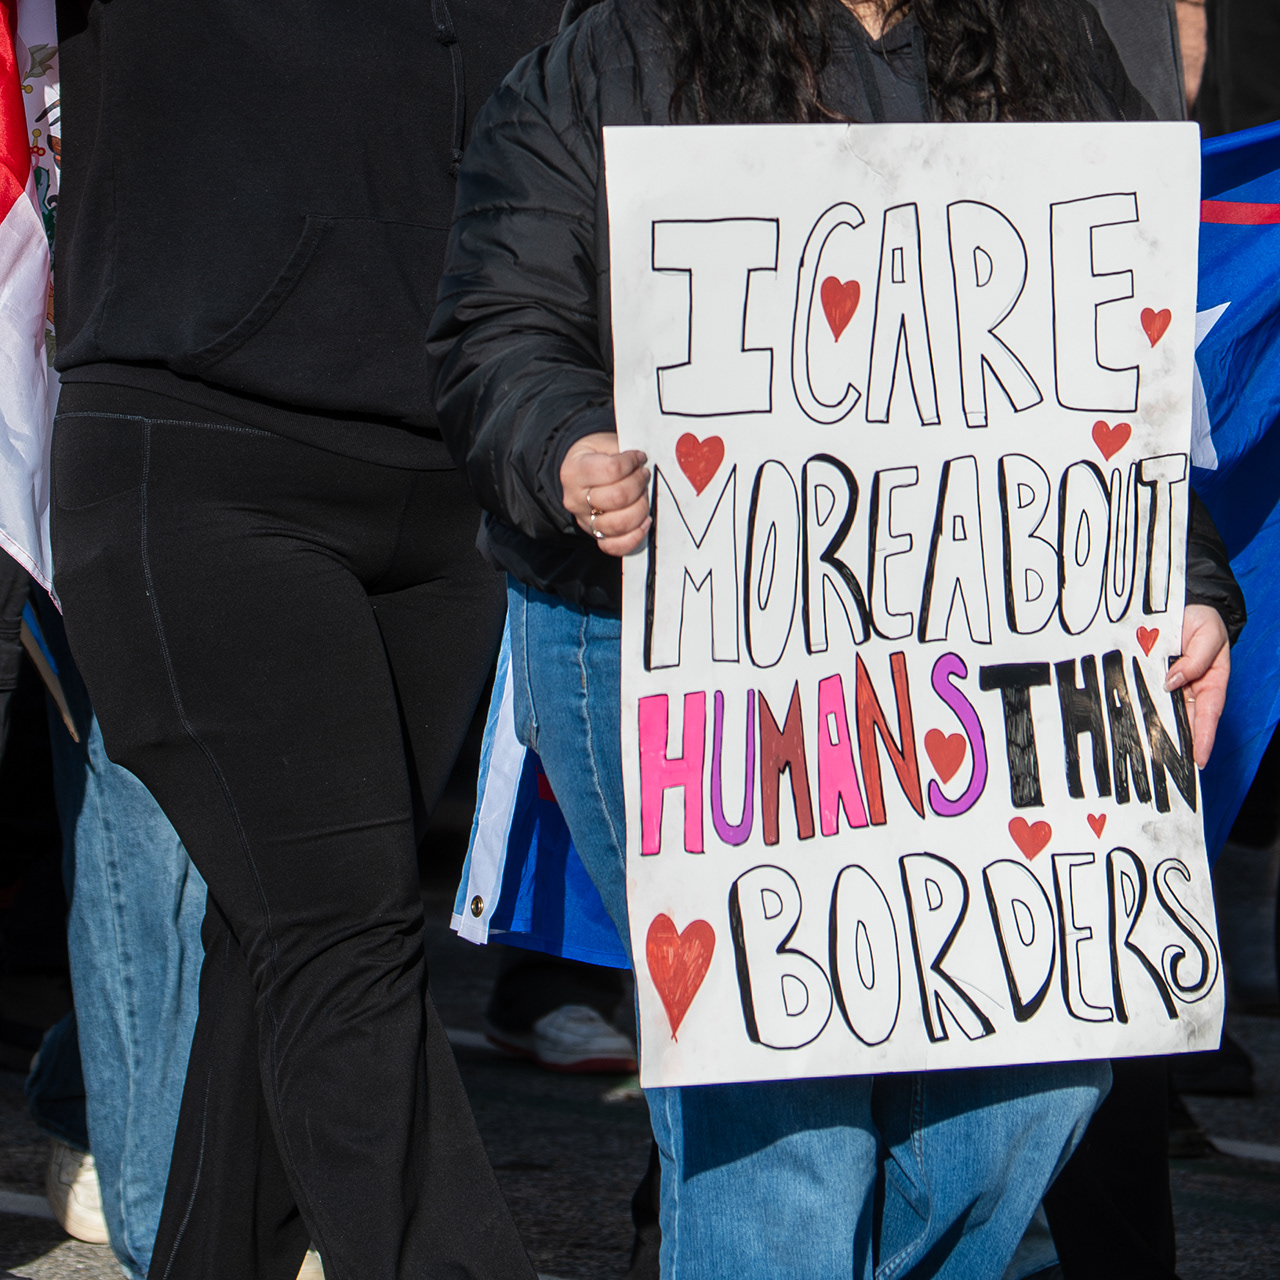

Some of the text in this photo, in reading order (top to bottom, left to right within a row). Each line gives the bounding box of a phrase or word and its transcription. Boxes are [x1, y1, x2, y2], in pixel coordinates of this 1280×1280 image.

[652, 192, 1140, 426] I CARE
[644, 453, 1187, 671] MORE ABOUT
[638, 650, 1198, 857] HUMANS THAN
[728, 848, 1221, 1050] BORDERS
